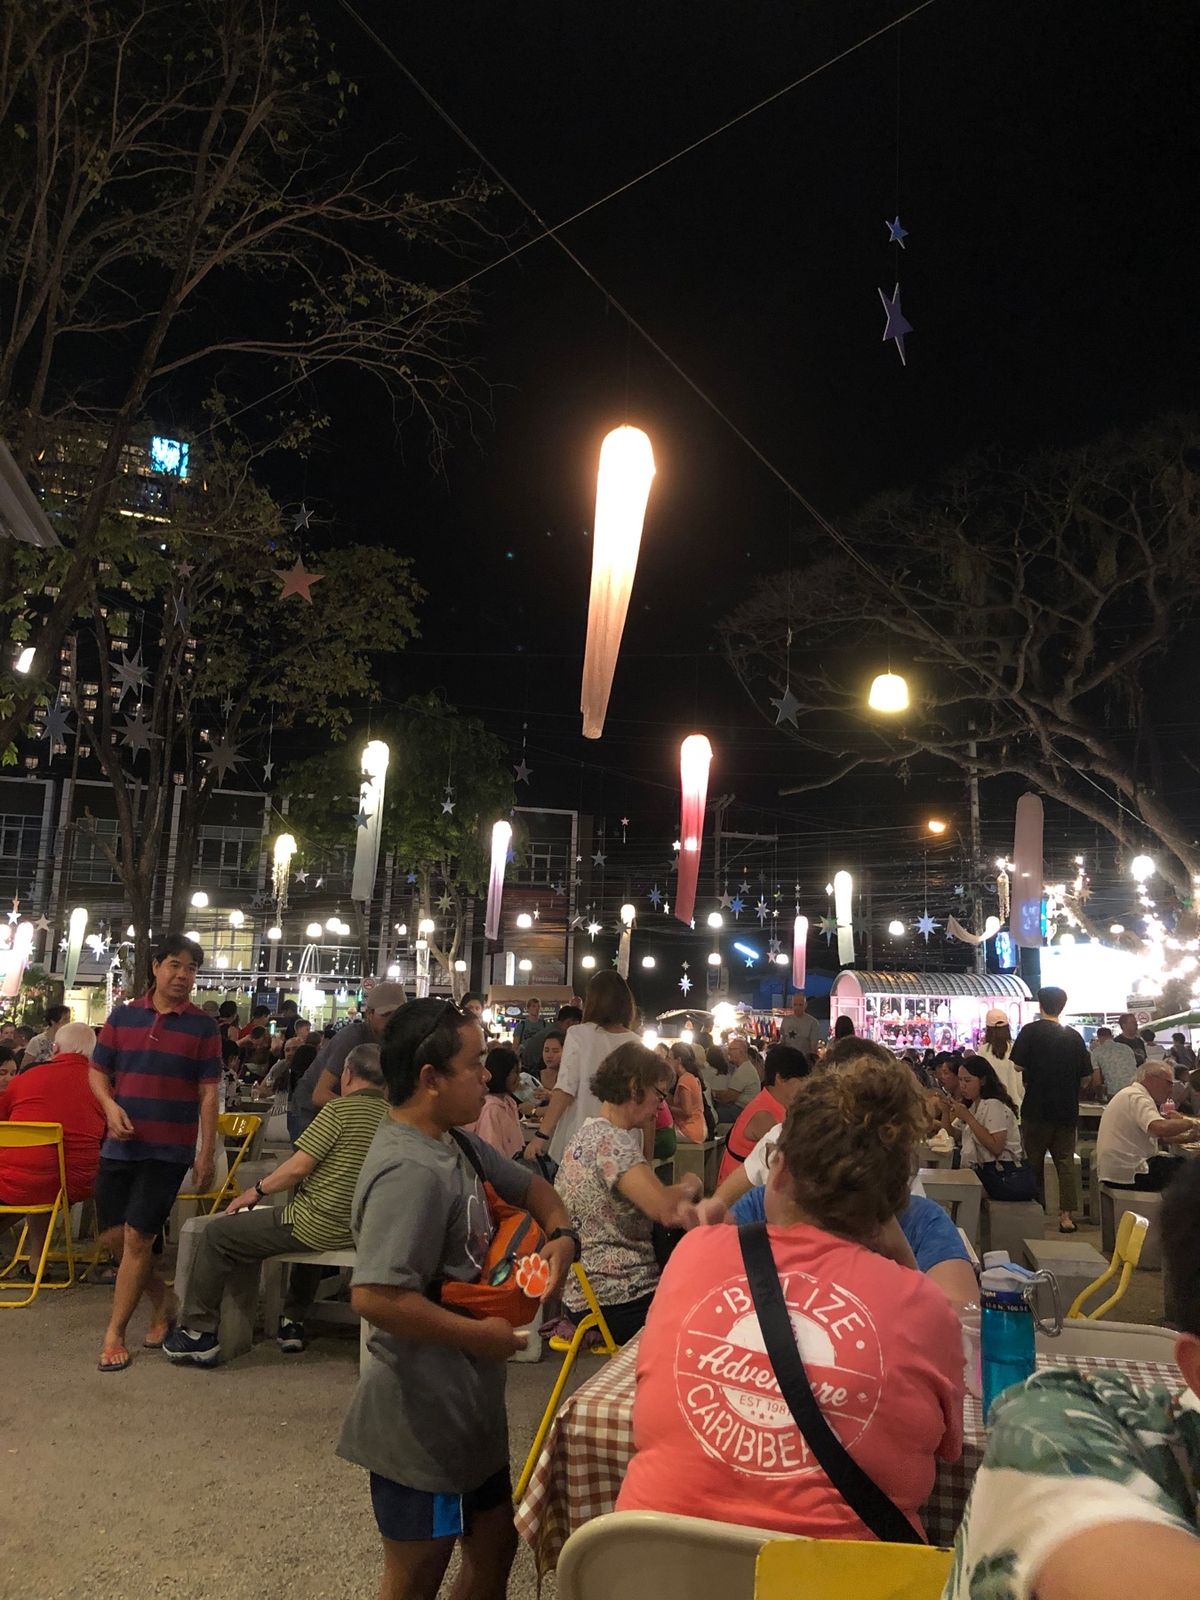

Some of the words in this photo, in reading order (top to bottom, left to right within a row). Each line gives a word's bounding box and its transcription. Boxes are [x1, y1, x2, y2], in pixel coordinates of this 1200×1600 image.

[723, 1278, 865, 1340] BLIZE
[697, 1344, 848, 1406] Advenre
[739, 1395, 761, 1408] EST
